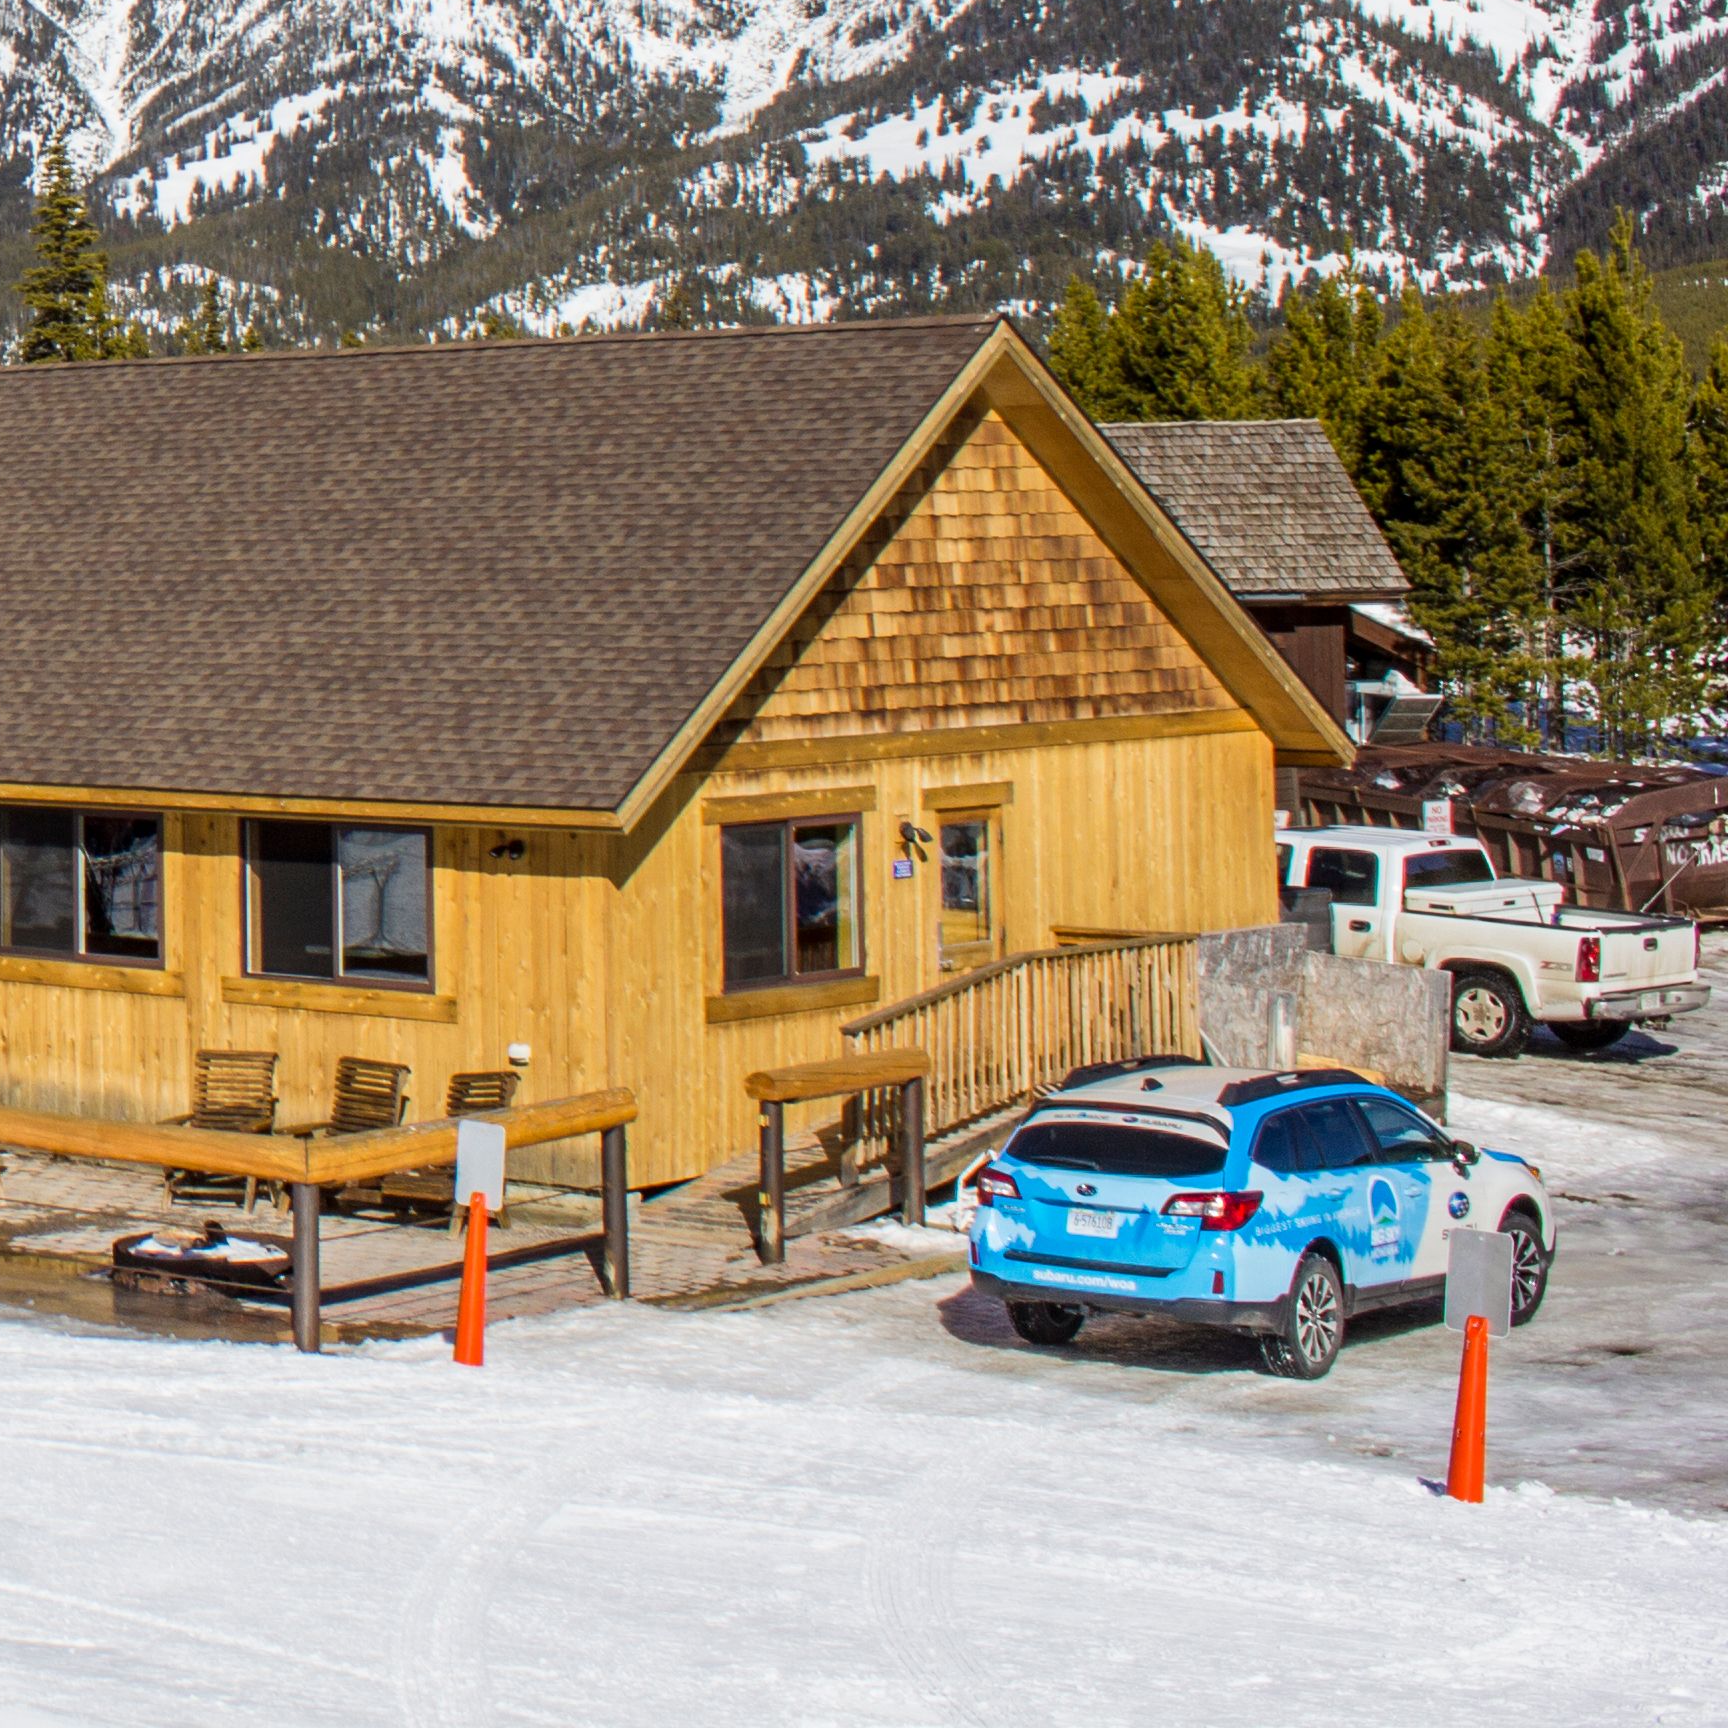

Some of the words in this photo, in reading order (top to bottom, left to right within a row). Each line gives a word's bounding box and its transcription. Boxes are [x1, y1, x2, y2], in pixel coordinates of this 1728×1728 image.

[1665, 842, 1688, 865] NO
[1255, 1219, 1293, 1237] BIGGEST
[1295, 1213, 1323, 1229] SKIING
[1032, 1269, 1137, 1291] subaru.com/woa
